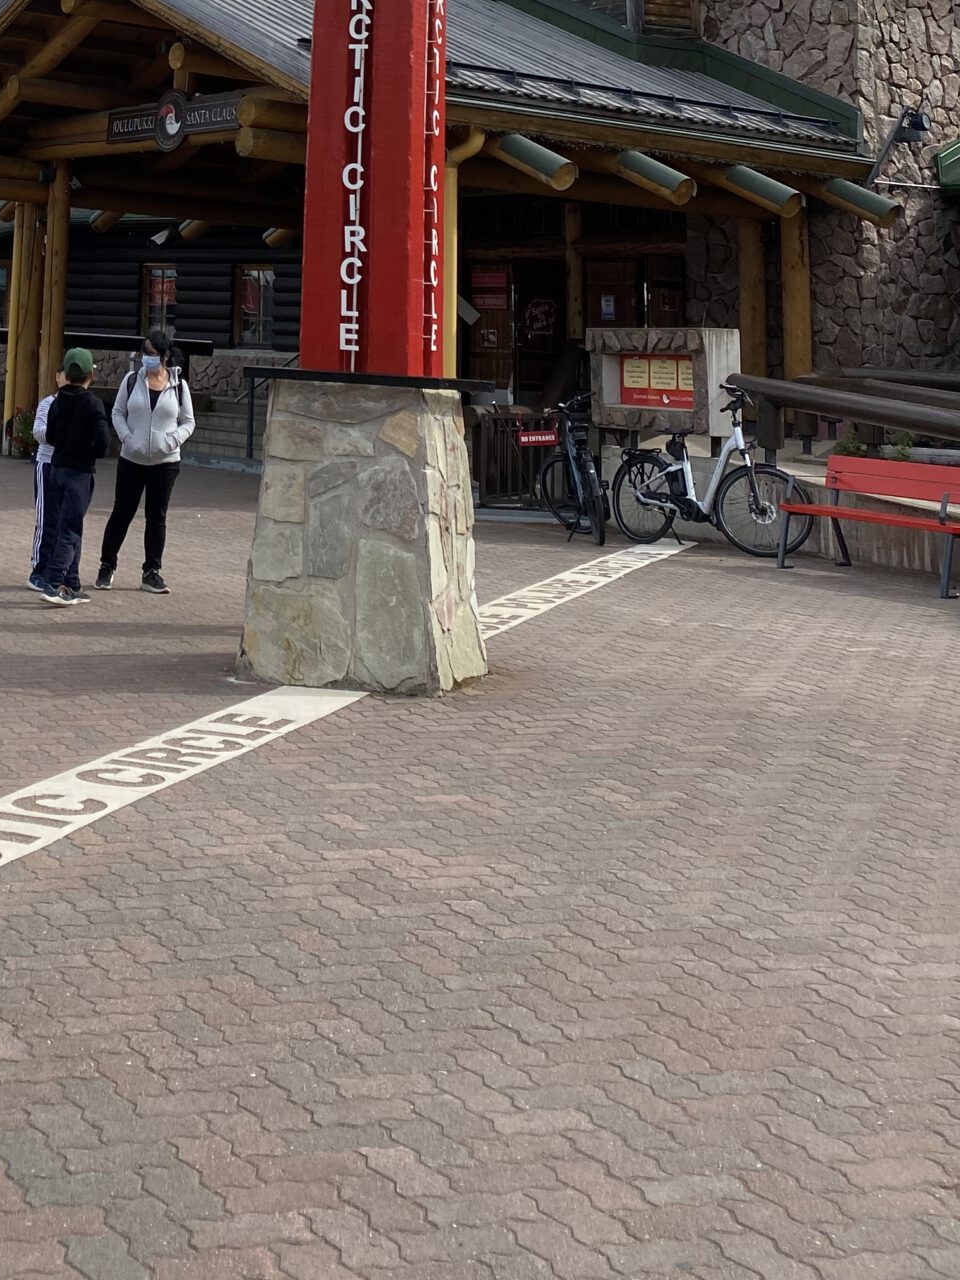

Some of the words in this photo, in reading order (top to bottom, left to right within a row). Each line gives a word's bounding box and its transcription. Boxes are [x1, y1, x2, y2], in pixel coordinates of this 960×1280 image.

[113, 116, 155, 134] JOULUPUKKI
[186, 110, 210, 125] SANTA
[212, 106, 236, 121] CLAUS
[339, 161, 367, 351] CIRCLE
[429, 164, 440, 352] CIRCLE
[75, 712, 294, 789] CIRCLE
